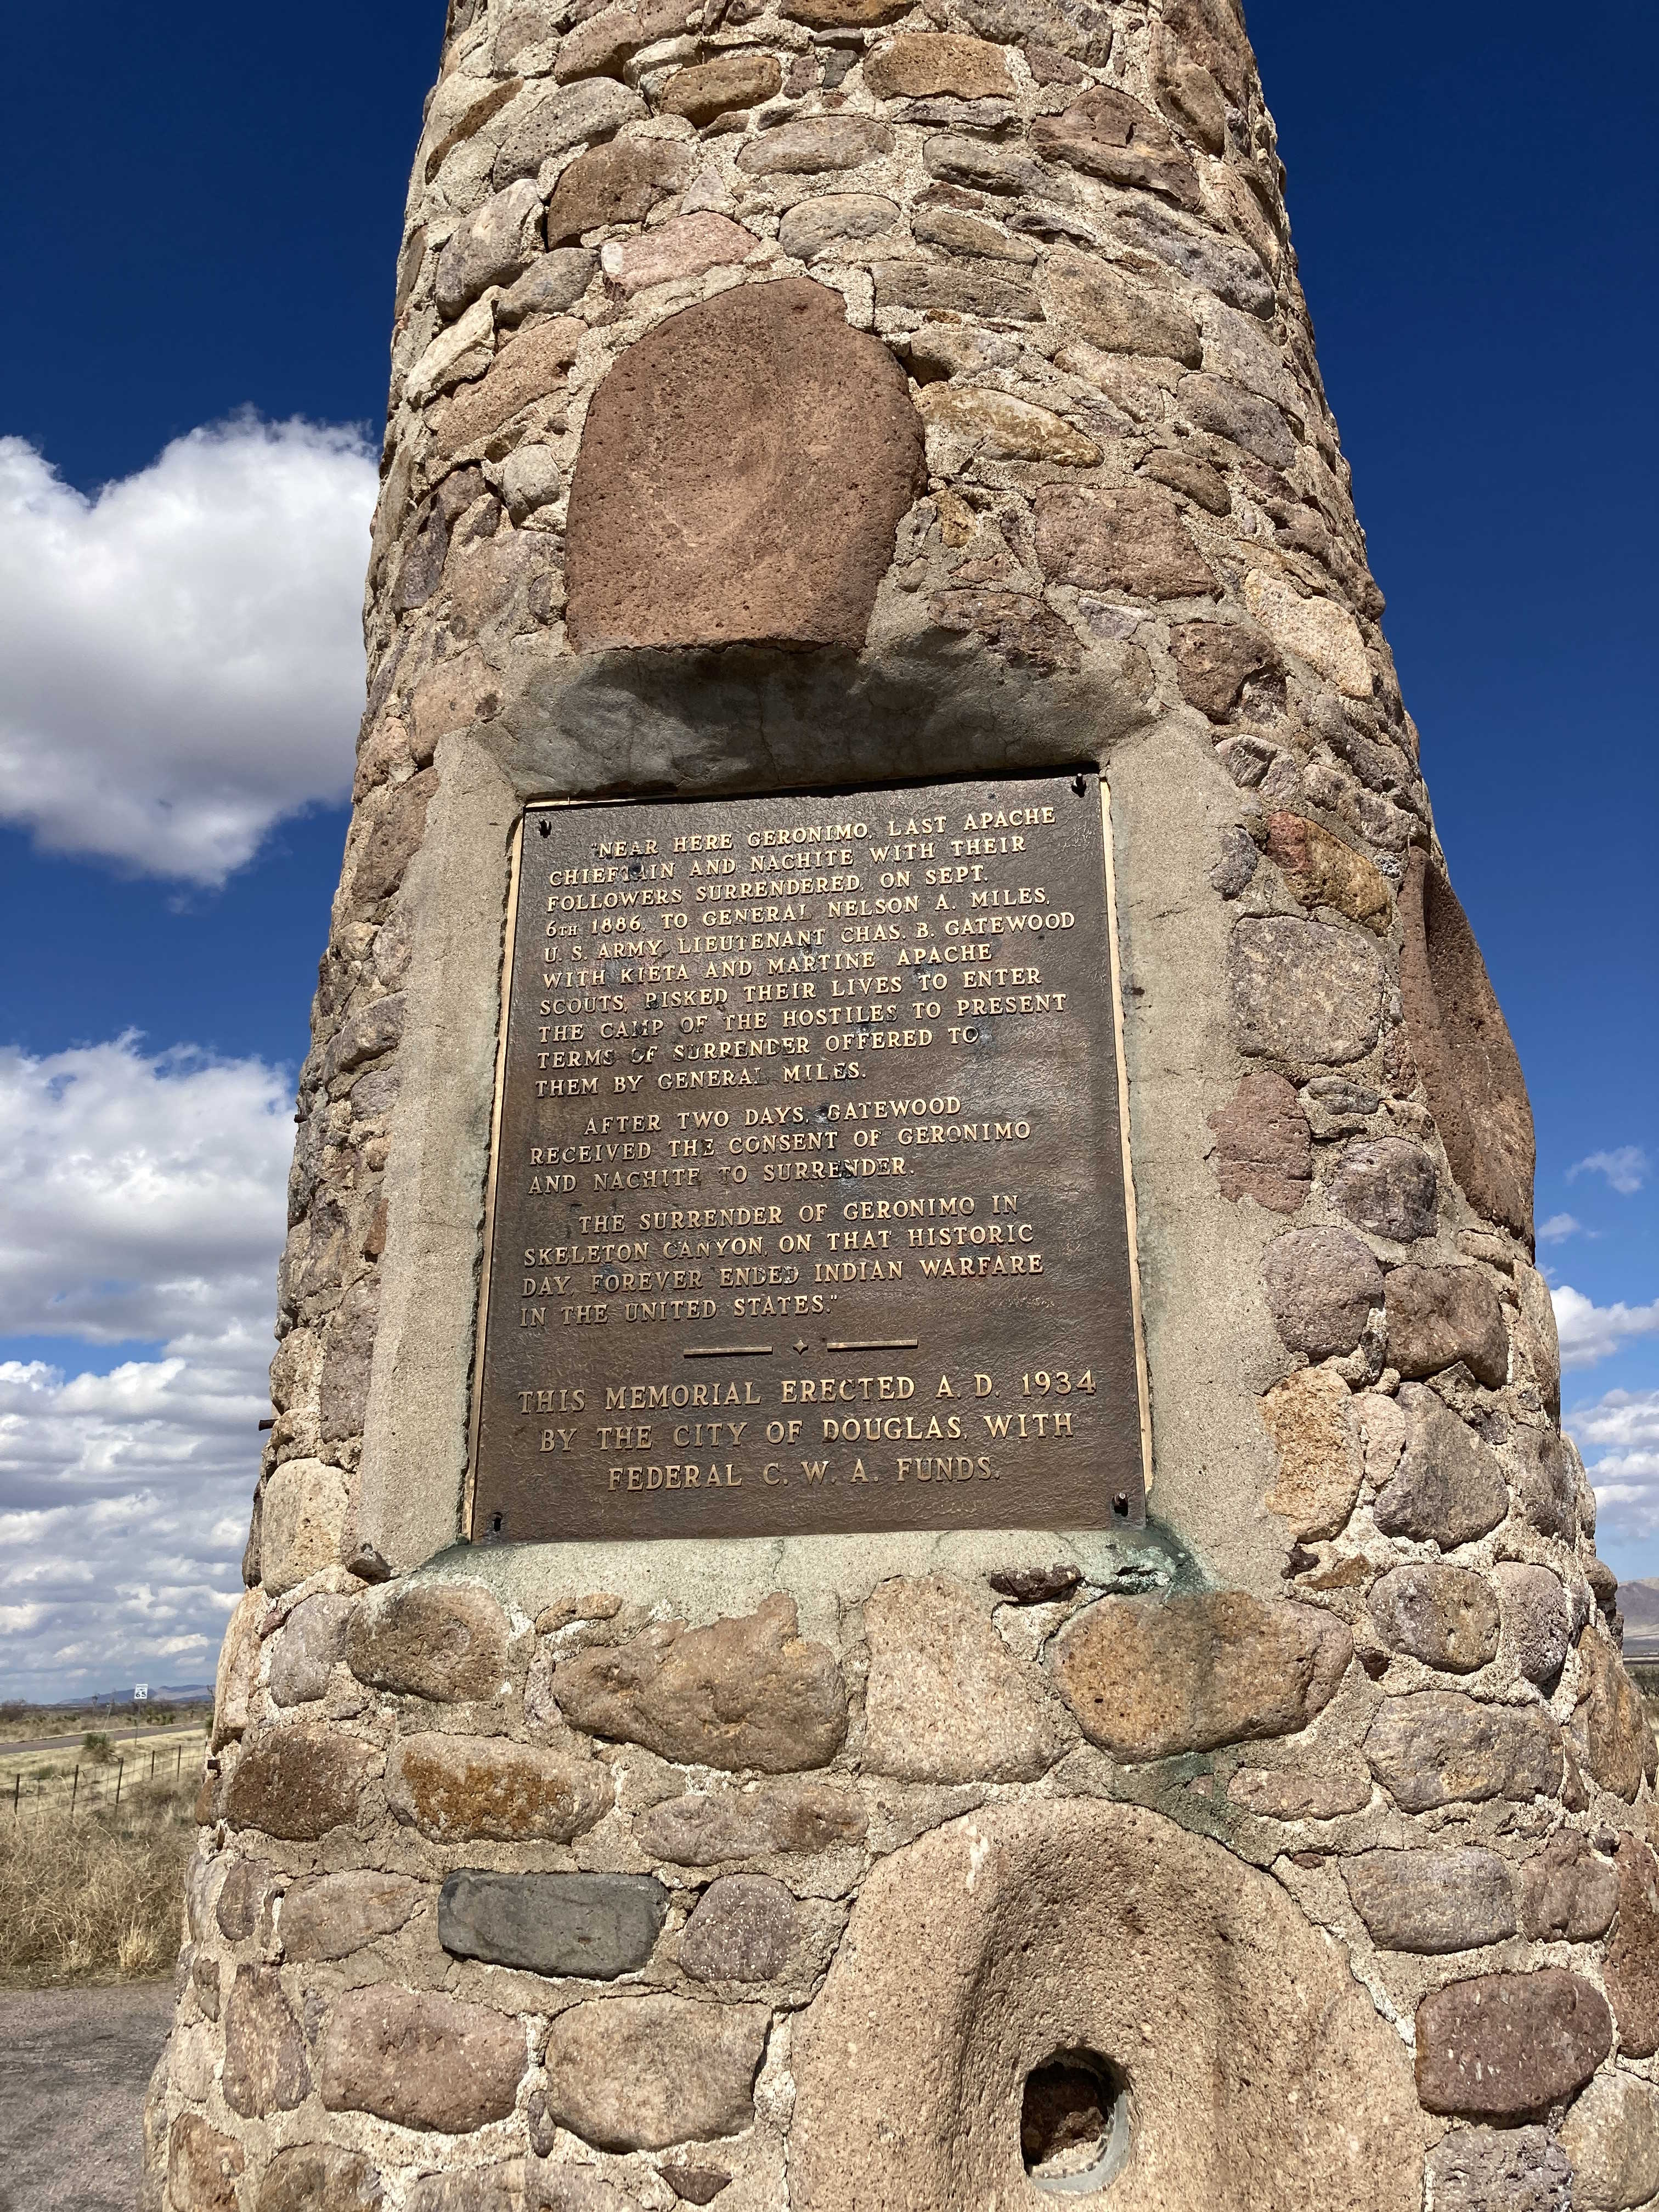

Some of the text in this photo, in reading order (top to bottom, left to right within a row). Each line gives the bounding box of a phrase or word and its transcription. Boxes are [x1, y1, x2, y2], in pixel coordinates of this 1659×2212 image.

[673, 833, 733, 854] HERE
[747, 822, 872, 848] GERONIMO,
[889, 816, 947, 837] LAST
[963, 807, 1056, 831] APACHE
[549, 836, 1026, 887] CHIEFTAIN AND NACHITE WITH THEIR
[547, 889, 682, 912] FOLLOWERS
[880, 871, 911, 889] ON
[926, 865, 989, 886] SEPT.
[591, 915, 647, 935] 1886,
[661, 913, 689, 931] TO
[702, 904, 813, 927] GENERAL
[828, 895, 920, 919] NELSON
[934, 894, 956, 912] A.
[970, 887, 1051, 909] MILES,
[544, 946, 562, 963] U.
[571, 945, 588, 962] S.
[678, 929, 826, 954] LIEUTENANT
[840, 924, 906, 944] CHAS.
[915, 922, 935, 939] B.
[945, 912, 1076, 936] GATEWOOD
[542, 944, 992, 990] WITH KIETA AND MARTINE APACHE
[645, 988, 727, 1010] RISKED
[743, 982, 817, 1003] THEIR
[832, 977, 902, 997] LIVES
[918, 973, 948, 991] TO
[963, 967, 1042, 989] ENTER
[539, 994, 1066, 1044] THE CAMP OF THE HOSTILES TO PRESENT
[537, 1026, 979, 1070] TERMS OF SURRENDER OFFERED TO
[535, 1062, 867, 1097] THEM BY GENERAL MILES.
[583, 1114, 662, 1136] AFTER
[678, 1110, 729, 1130] TWO
[827, 1096, 961, 1121] GATEWOOD
[530, 1121, 1030, 1166] RECEIVED THE CONSENT OF GERONIMO
[528, 1157, 915, 1195] AND NACHITE TO SURRENDER.
[579, 1195, 1019, 1234] THE SURRENDER OF GERONIMO IN
[523, 1242, 649, 1268] SKELETON
[780, 1234, 811, 1254] ON
[827, 1230, 892, 1252] THAT
[908, 1224, 1034, 1248] HISTORIC
[591, 1270, 703, 1294] FOREVER
[719, 1266, 799, 1287] ENDED
[815, 1261, 904, 1283] INDIAN
[919, 1254, 1044, 1279] WARFARE
[520, 1307, 546, 1328] IN
[561, 1305, 609, 1325] THE
[625, 1300, 718, 1322] UNITED
[518, 1369, 1096, 1415] THIS MEMORIAL ERECTED A. D. 1934
[539, 1413, 1074, 1453] BY THE CITY OF DOUGLAS, WITH
[608, 1456, 1000, 1492] FEDERAL C. W. A. FUNDS.
